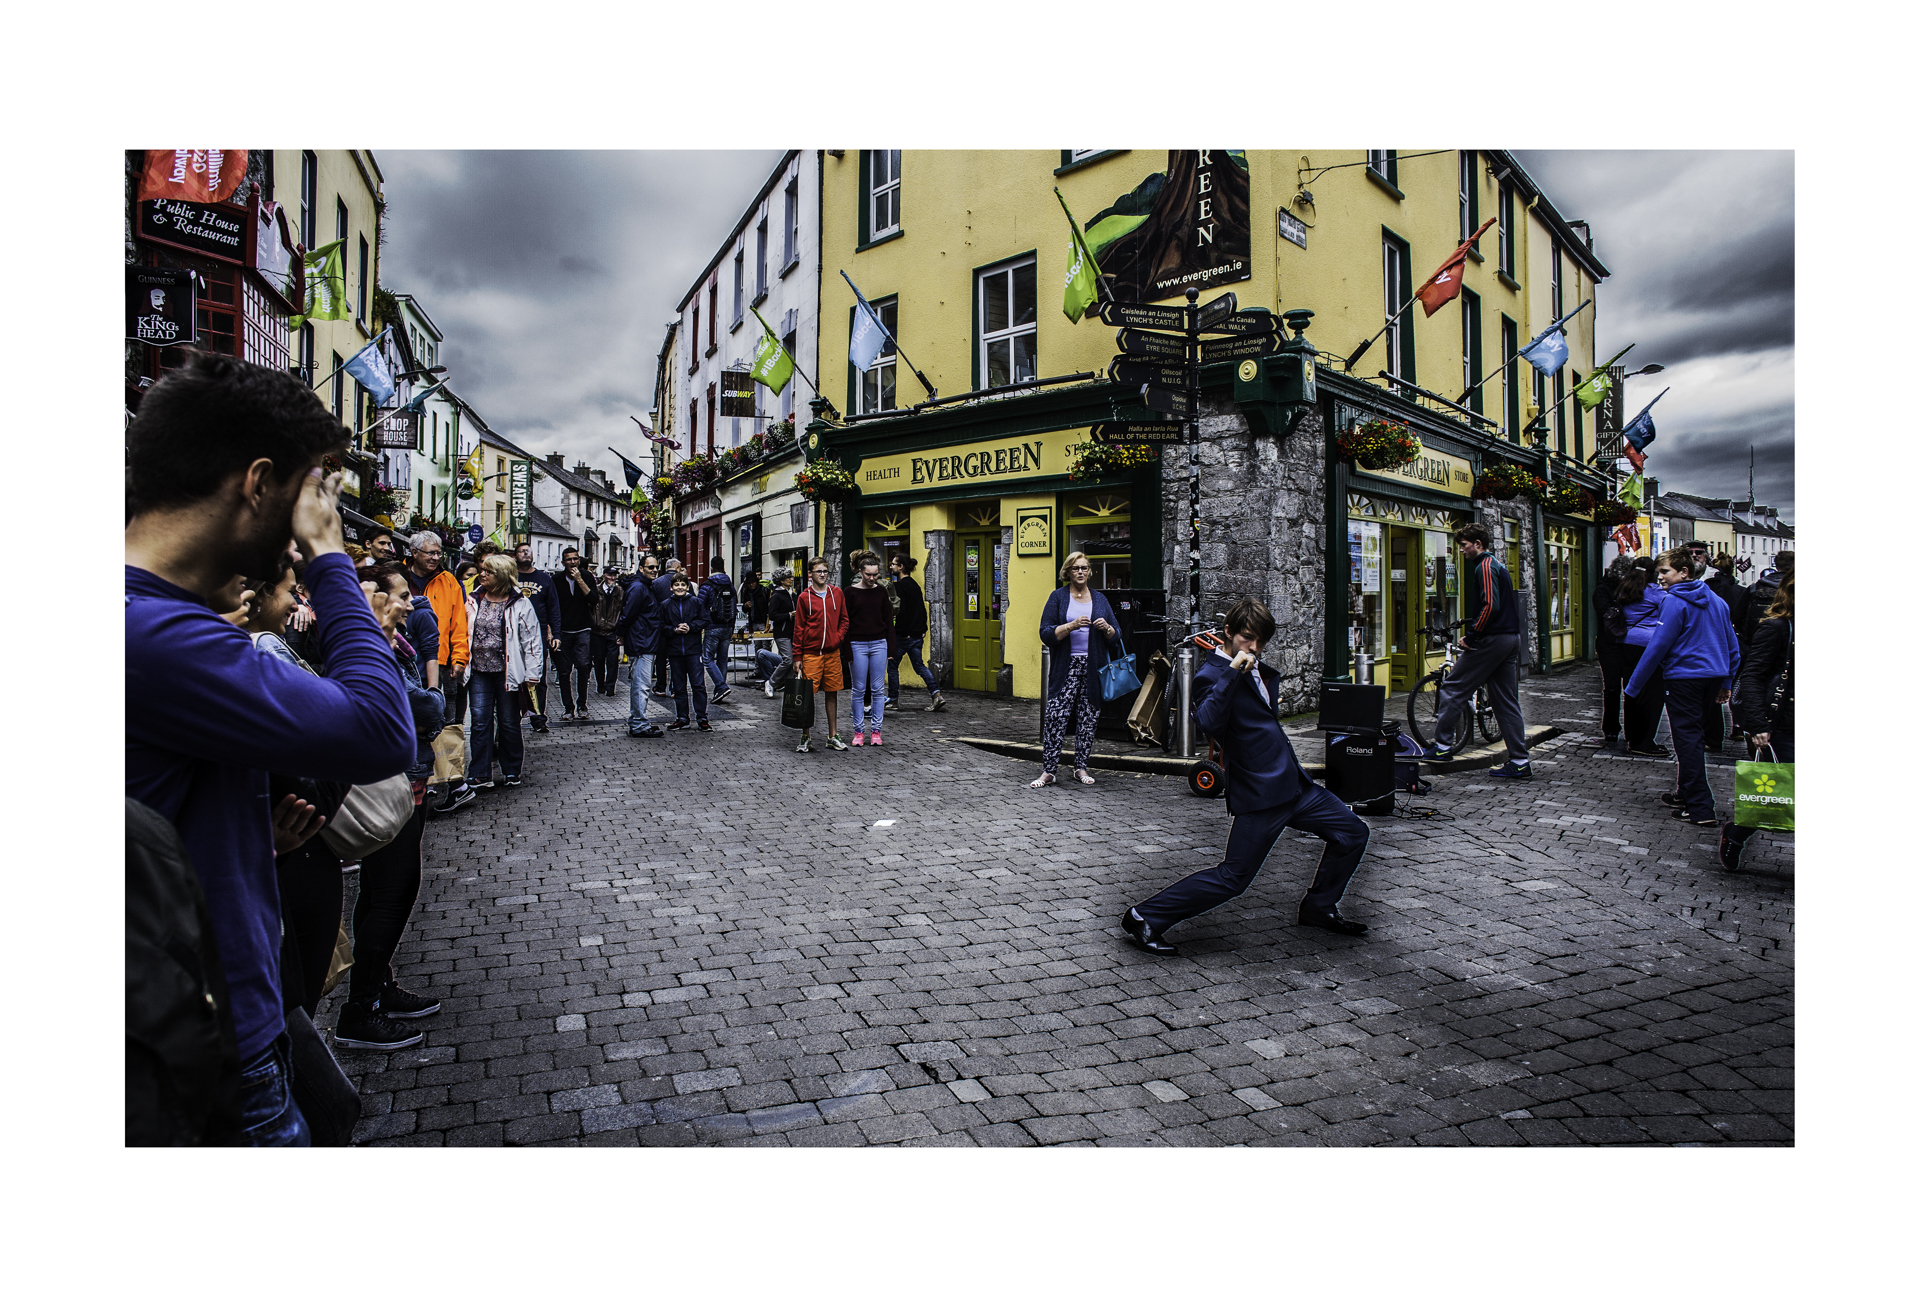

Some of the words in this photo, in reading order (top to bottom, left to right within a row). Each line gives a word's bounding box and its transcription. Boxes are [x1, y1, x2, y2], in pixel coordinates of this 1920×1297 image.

[153, 199, 196, 220] Public
[200, 210, 240, 232] House
[152, 213, 168, 224] &
[173, 216, 240, 247] Restaurant
[138, 274, 176, 285] GUINNESS
[1156, 260, 1242, 289] www.evergreen.ie
[1126, 316, 1153, 324] LYNCH'S
[1157, 311, 1179, 319] Linsigh
[137, 329, 176, 339] HEAD
[1149, 336, 1169, 345] Fhaiche
[1206, 342, 1233, 350] Fuinneog
[1243, 337, 1267, 345] Linsigh
[1146, 344, 1160, 352] EYRE
[1161, 346, 1183, 355] SQUARE
[1205, 350, 1231, 359] LYNCH'S
[1232, 346, 1261, 355] WINDOW
[722, 390, 755, 398] SUBWAY
[383, 431, 408, 441] HOUSE
[866, 467, 900, 481] HEALTH
[911, 441, 1043, 484] EVERGREEN
[1454, 470, 1469, 483] STORE
[512, 464, 527, 517] SWEATERS
[1020, 522, 1047, 538] EVERGREEN
[1346, 746, 1373, 754] Roland
[1739, 794, 1793, 805] evergreen
